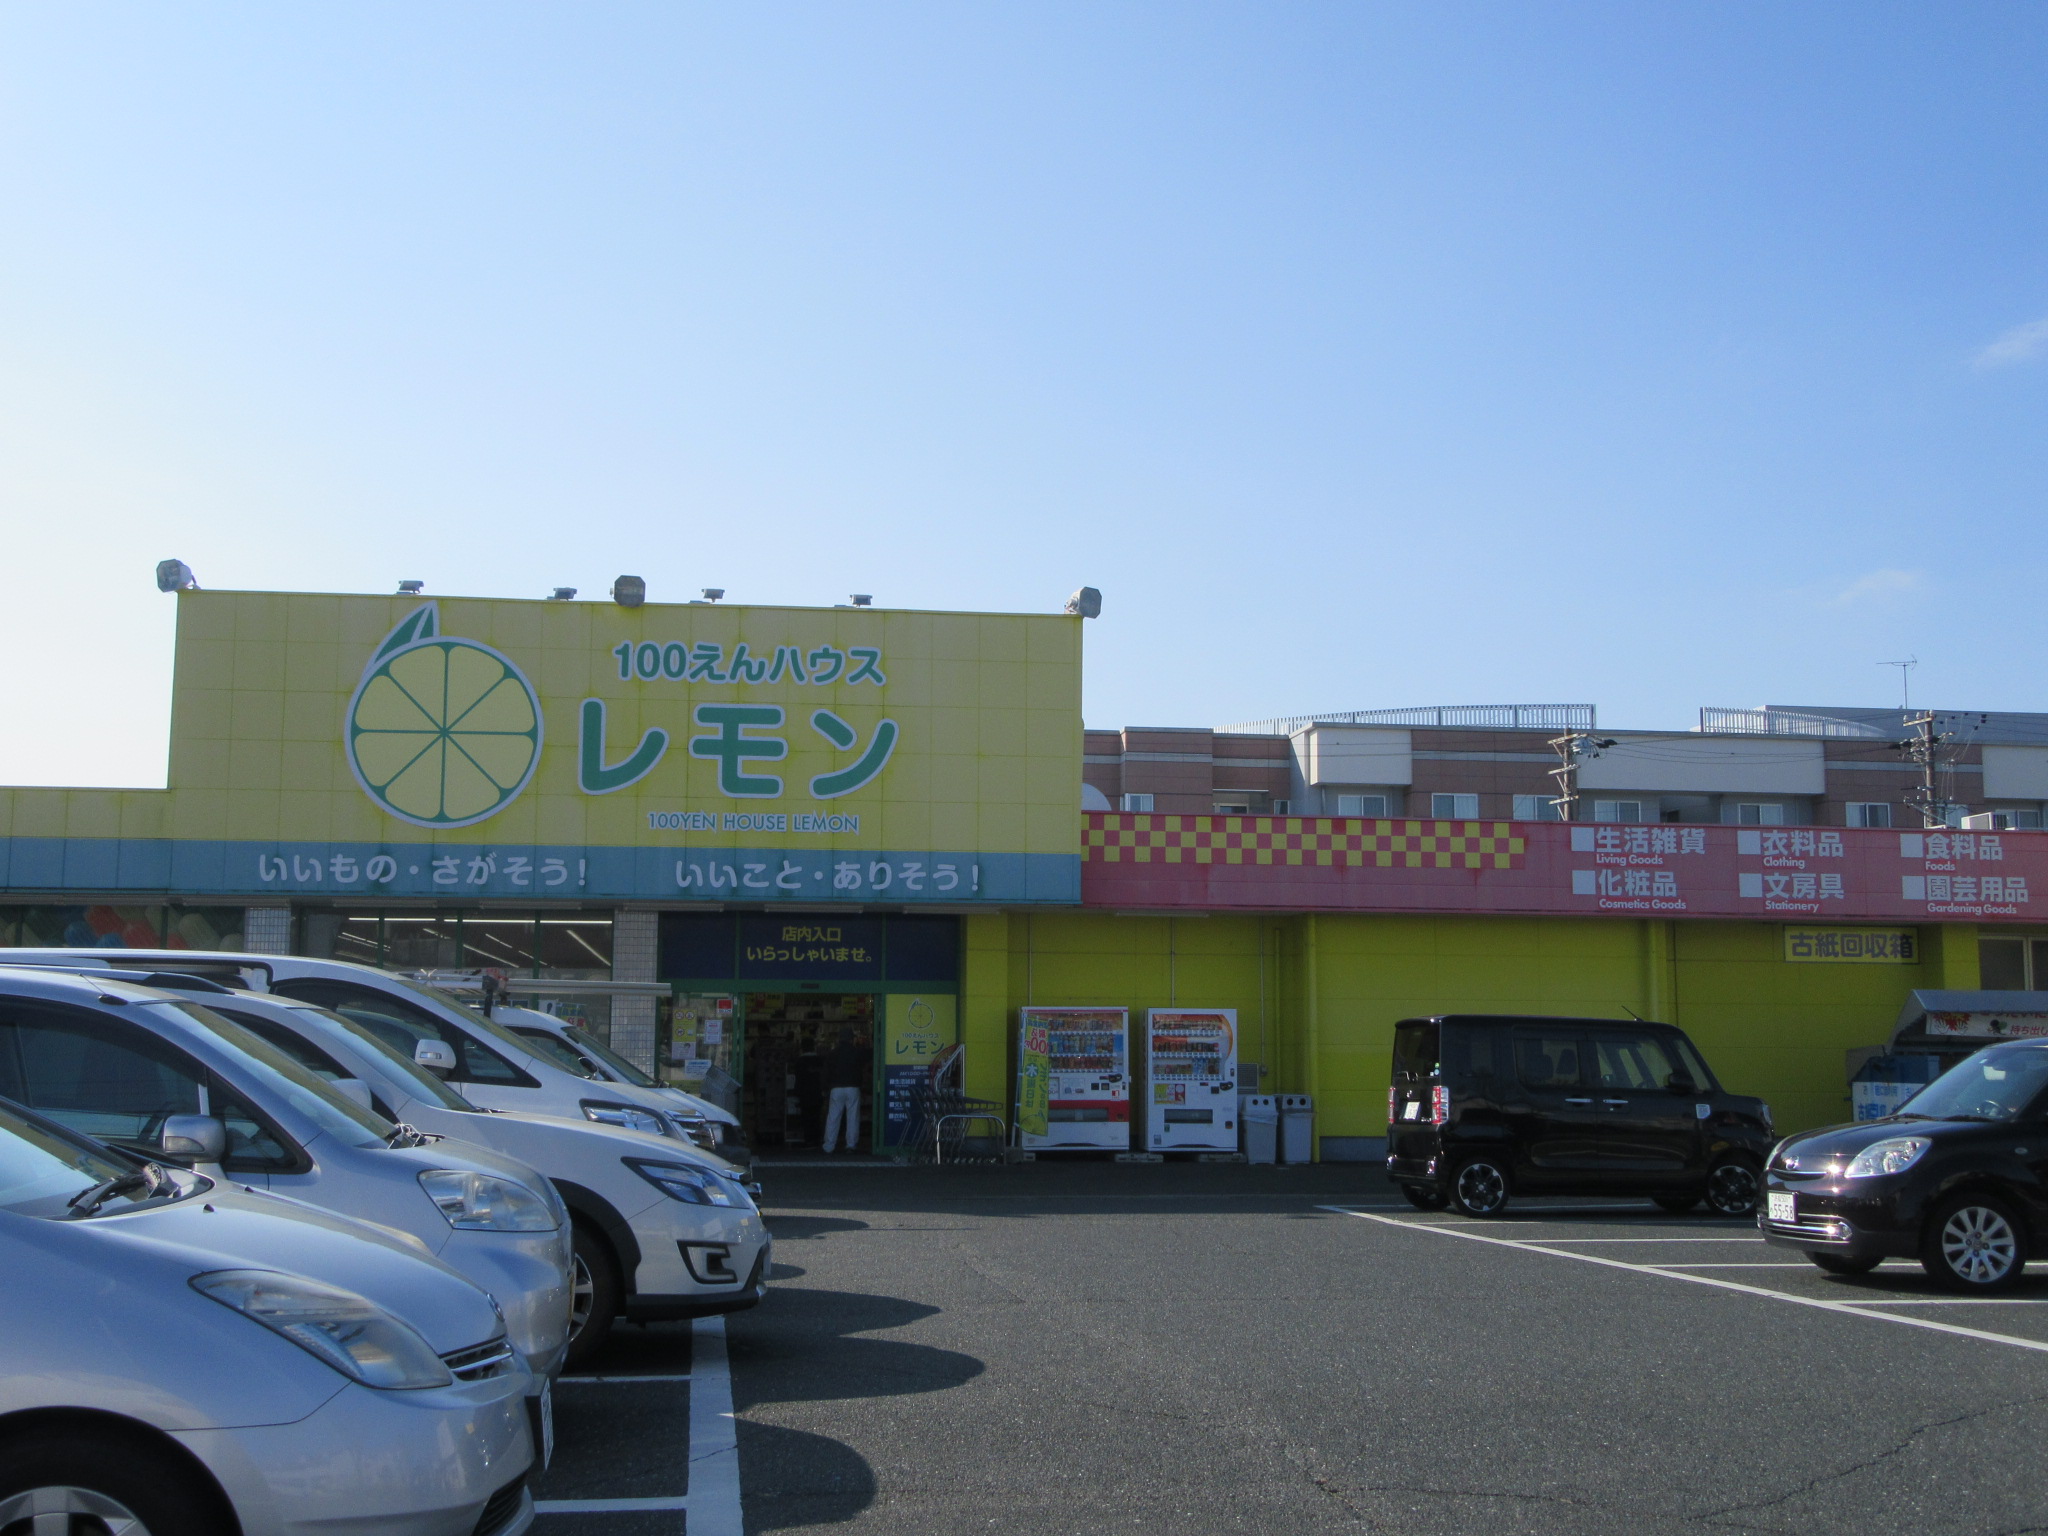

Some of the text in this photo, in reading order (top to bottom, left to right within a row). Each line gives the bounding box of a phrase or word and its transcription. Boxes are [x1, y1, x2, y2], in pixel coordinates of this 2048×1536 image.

[615, 640, 886, 686] 100えんハウス
[579, 697, 899, 800] レモン
[649, 813, 859, 833] 100YEN HOUSE LEMON
[1596, 827, 1705, 854] 生活雑貨
[1763, 830, 1844, 857] 衣料品
[1925, 833, 2003, 861] 食料品
[1596, 854, 1663, 866] Living Goods
[1763, 857, 1805, 869] Clothing
[1925, 861, 1955, 871] Foods
[1598, 870, 1677, 897] 化粧品
[1764, 873, 1844, 900] 文房具
[1927, 875, 2029, 903] 園芸用品
[1599, 898, 1686, 910] Cosmetics Goods
[1765, 900, 1820, 913] Stationery
[1927, 903, 2017, 916] Gardening Goods
[782, 926, 841, 942] 店内入口
[747, 946, 872, 963] いらっしゃいませ。
[1789, 932, 1914, 959] 古紙回収箱
[895, 1040, 944, 1055] レモン
